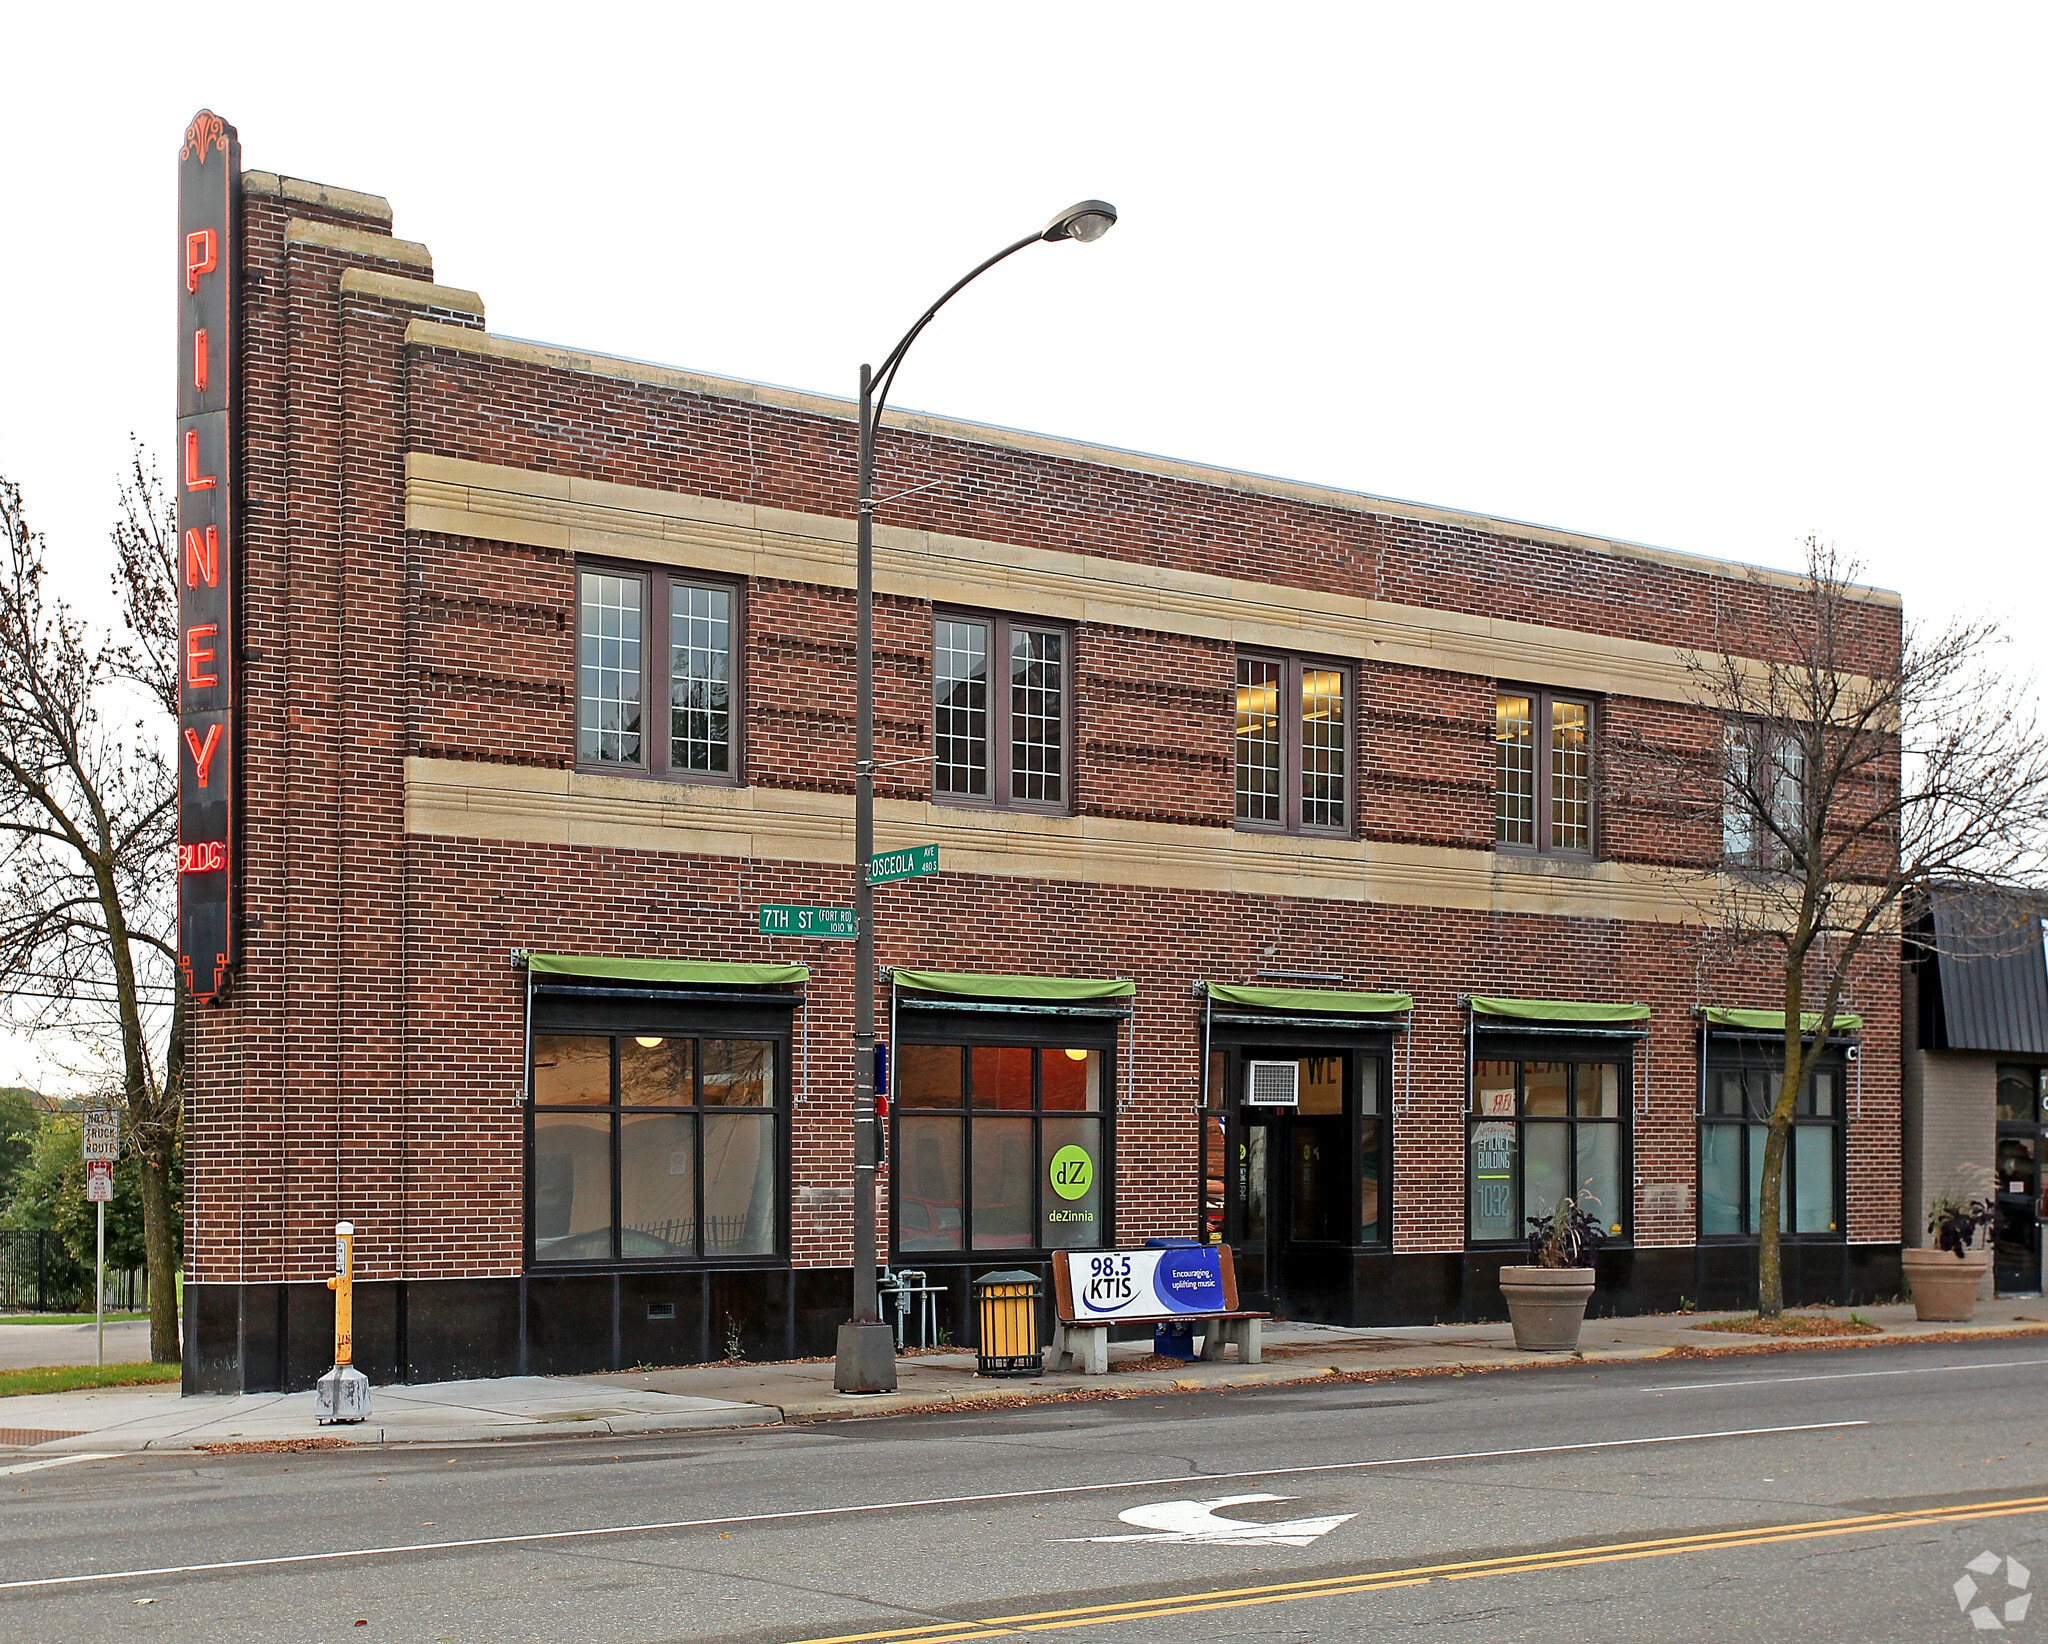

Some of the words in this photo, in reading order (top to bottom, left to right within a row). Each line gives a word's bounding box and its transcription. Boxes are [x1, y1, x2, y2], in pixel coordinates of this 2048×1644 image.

[184, 227, 224, 788] PILNEY
[177, 841, 226, 872] BLDG
[923, 846, 936, 858] AVE
[872, 853, 915, 877] OSCEOLA
[932, 860, 938, 871] S
[763, 908, 789, 928] 7TH
[798, 910, 814, 929] ST
[818, 908, 838, 922] (FORT
[840, 910, 852, 923] RD)
[830, 923, 845, 932] 1010
[847, 923, 854, 932] W
[86, 1127, 116, 1140] TRUCK
[86, 1142, 116, 1153] ROUTE
[1477, 1151, 1510, 1169] BUILDING
[1056, 1160, 1086, 1185] dZ
[1477, 1185, 1510, 1217] 1032
[1048, 1209, 1095, 1223] deZinnia
[1090, 1256, 1131, 1278] 98.5
[1172, 1268, 1213, 1280] Encouraging,
[1090, 1276, 1132, 1300] KTIS
[1171, 1279, 1198, 1291] uplifting
[1197, 1278, 1216, 1288] music
